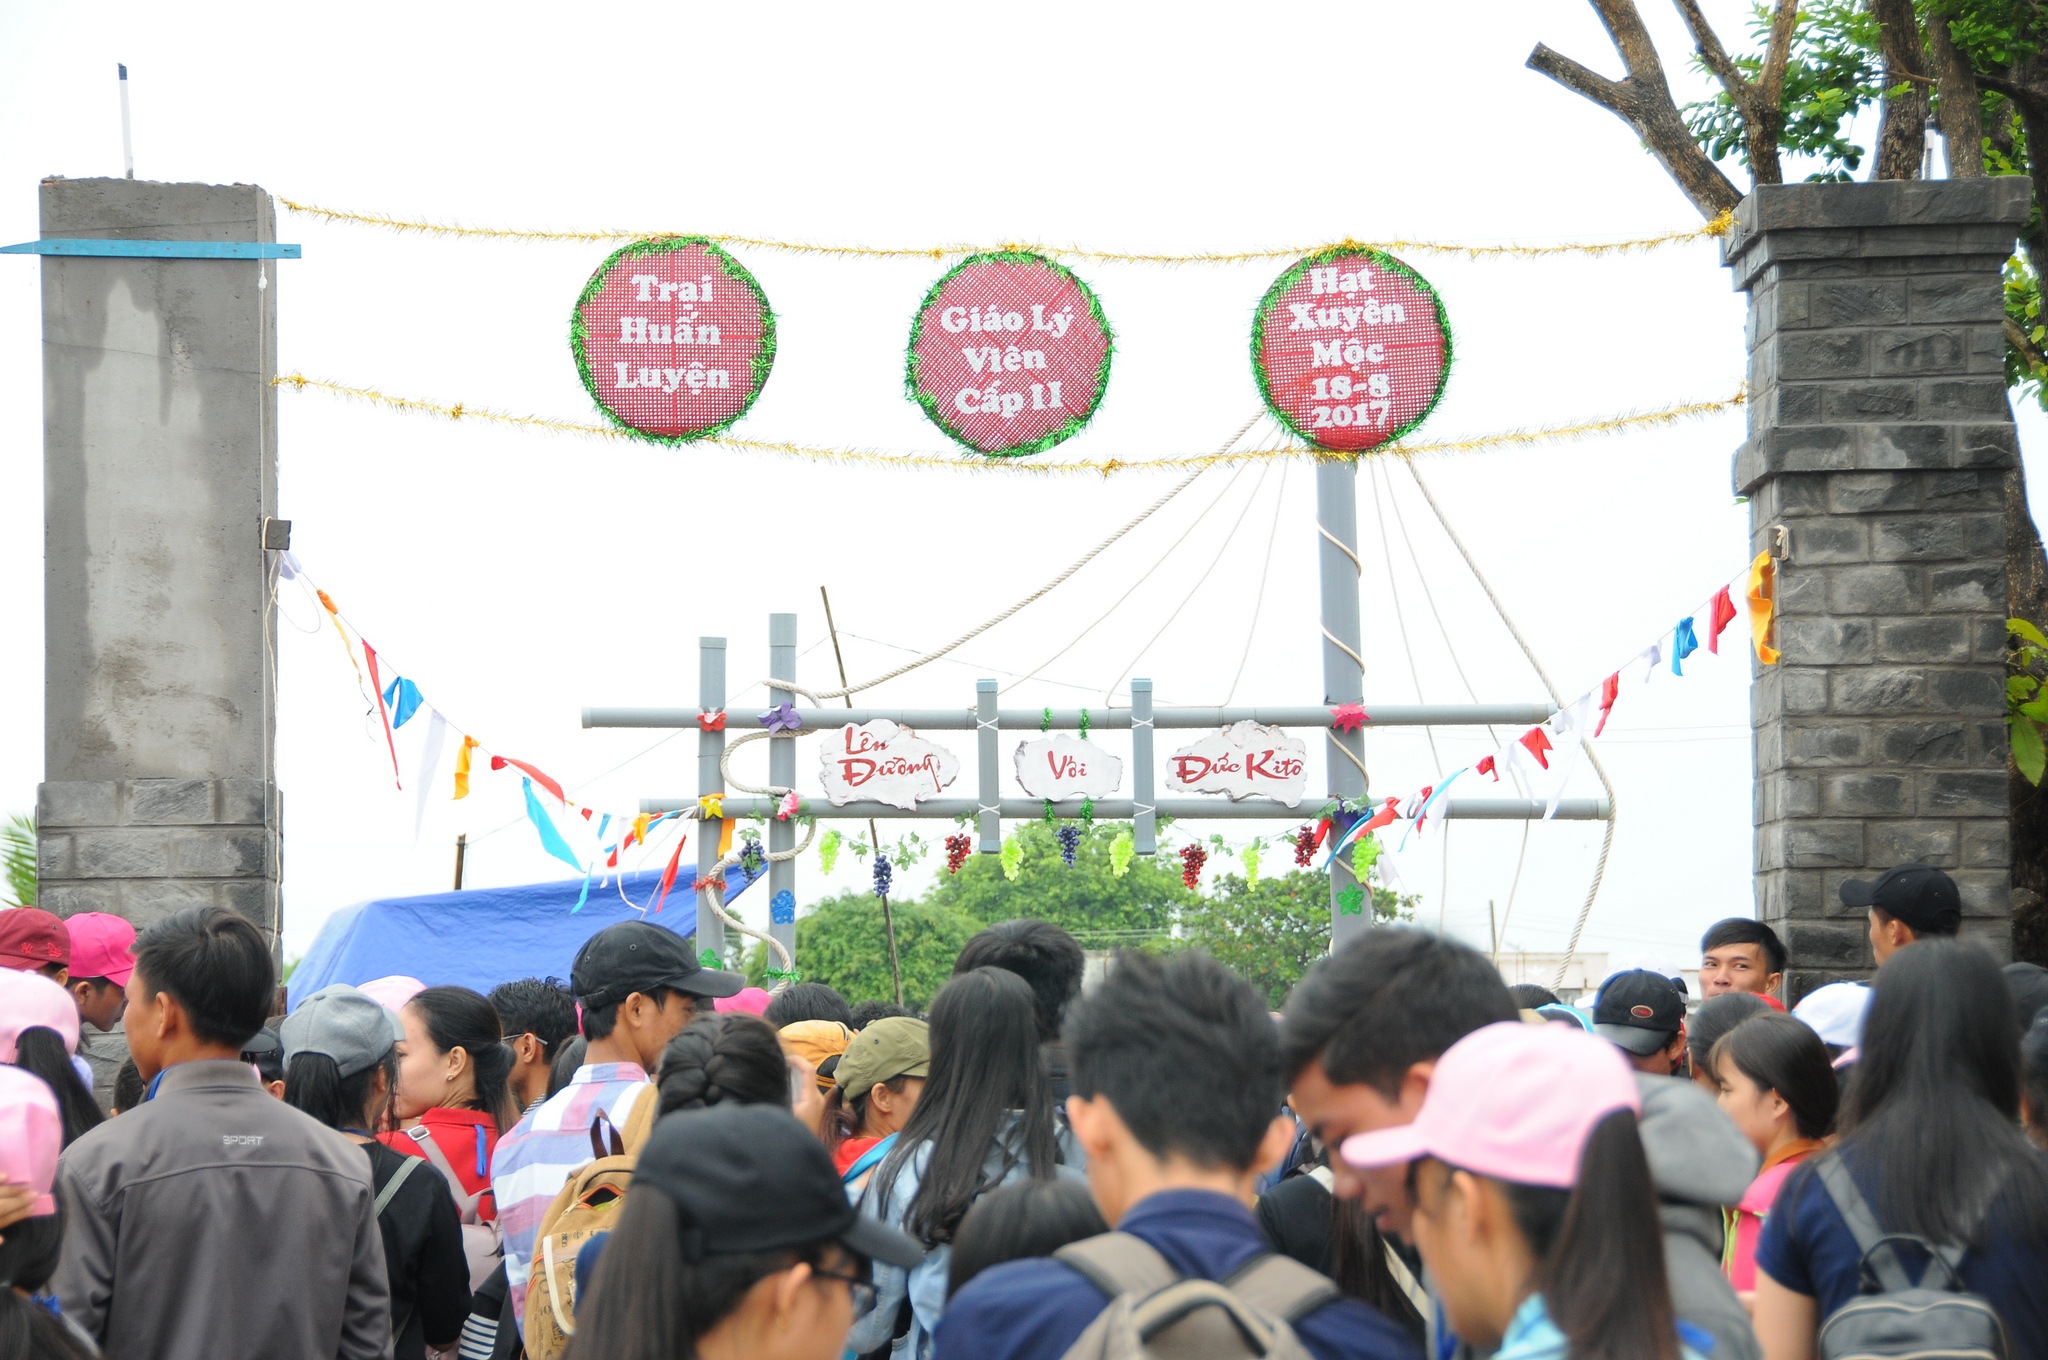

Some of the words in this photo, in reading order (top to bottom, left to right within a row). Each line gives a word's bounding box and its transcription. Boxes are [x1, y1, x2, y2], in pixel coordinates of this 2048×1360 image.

[631, 274, 714, 310] Trại
[1309, 267, 1376, 299] Hạt
[619, 312, 721, 345] Huấn
[940, 304, 1024, 334] Giáo
[1031, 303, 1074, 338] Lý
[1288, 297, 1406, 333] Xuyên
[961, 345, 1047, 373] Viên
[1310, 339, 1385, 372] Mộc
[614, 362, 730, 395] Luyện
[1310, 373, 1391, 400] 18-8
[955, 379, 1024, 419] Cấp
[1311, 400, 1391, 429] 2017
[844, 726, 890, 755] Lên
[1171, 752, 1241, 784] Đức
[1245, 749, 1304, 781] Kitô
[222, 1135, 264, 1146] SPORT
